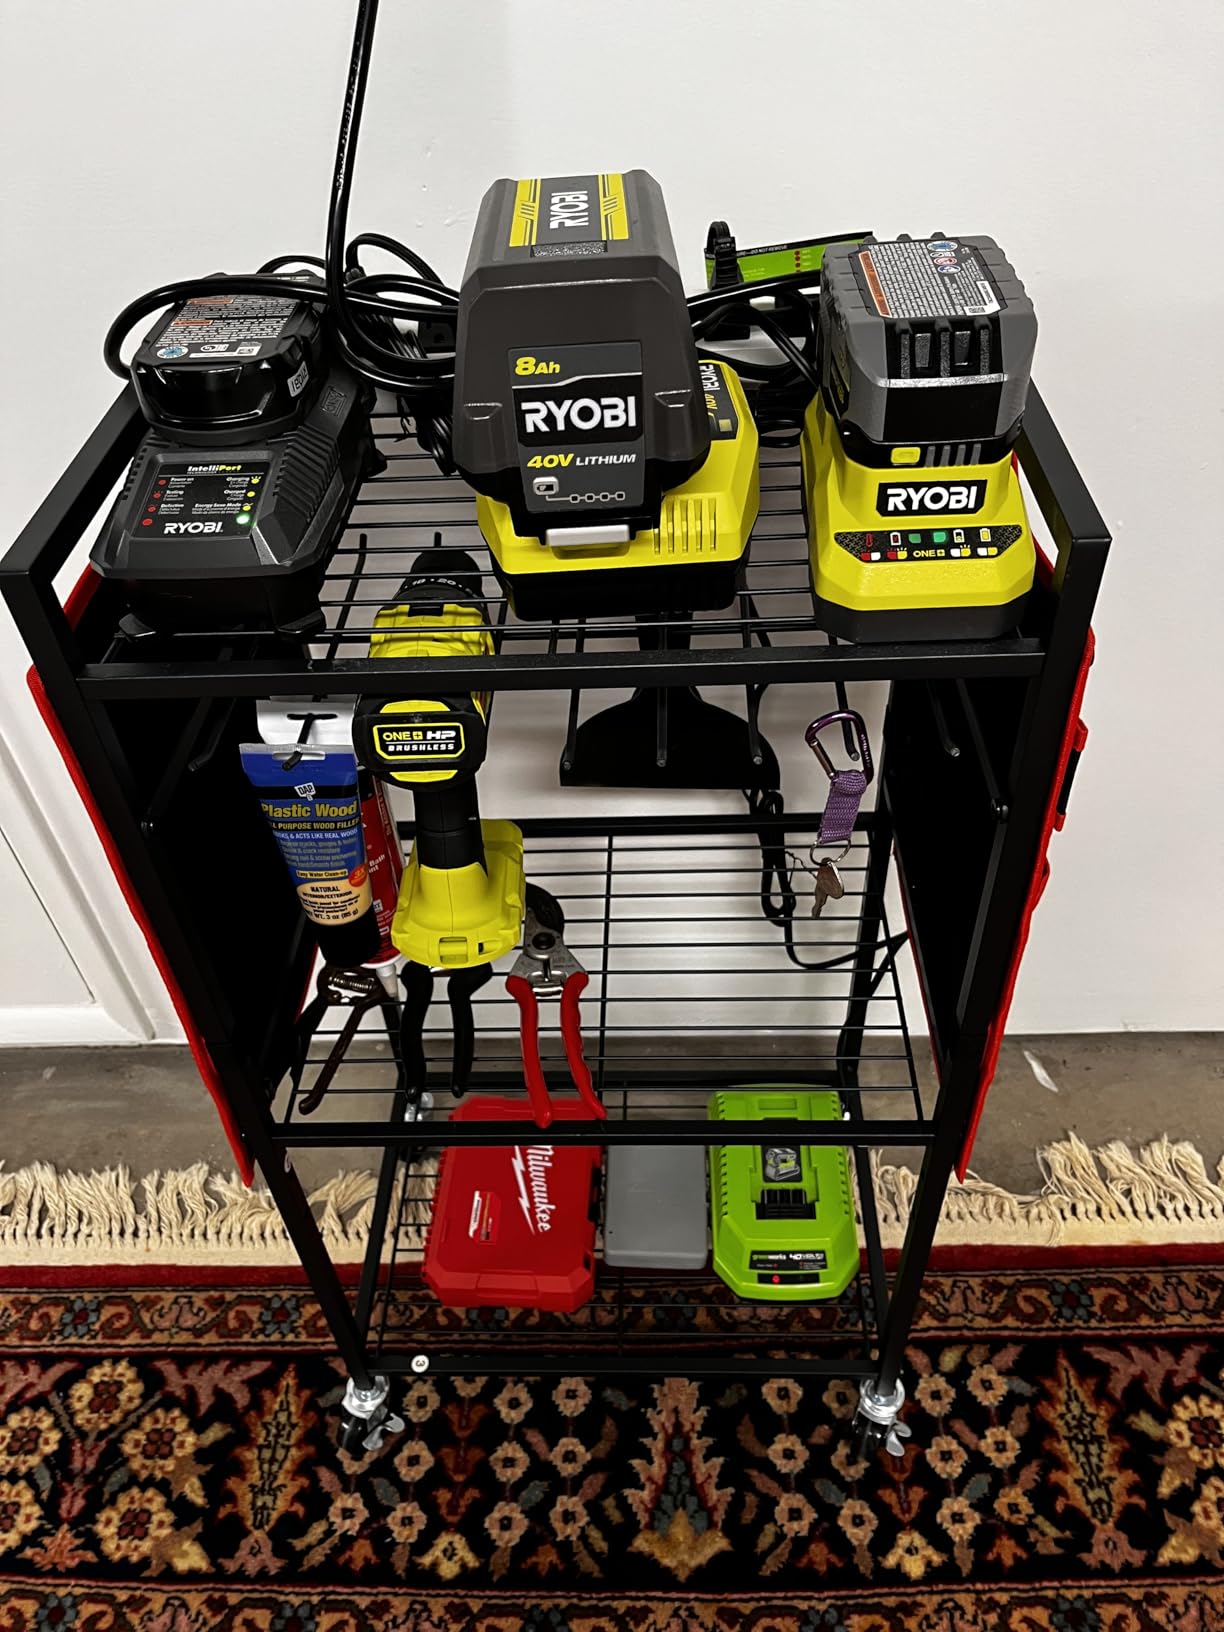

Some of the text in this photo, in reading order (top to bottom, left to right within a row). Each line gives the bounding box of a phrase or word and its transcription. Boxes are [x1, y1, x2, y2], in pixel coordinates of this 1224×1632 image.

[549, 190, 590, 230] RYOBI
[514, 356, 561, 376] 8Ah
[699, 364, 721, 391] RYOBI
[704, 393, 718, 410] 40V
[520, 396, 638, 433] RYOBI
[527, 453, 637, 468] 40V LITHIUM
[887, 485, 978, 511] RYOBI
[163, 521, 223, 534] RYOBI
[426, 730, 456, 740] HP
[387, 743, 455, 752] BRUSHLESS
[297, 784, 315, 796] DAP
[260, 800, 358, 818] Plastic Wood
[277, 821, 312, 830] PURPOSE
[313, 821, 336, 829] WOOD
[325, 831, 340, 839] REAL
[526, 1145, 556, 1233] Milwaukee
